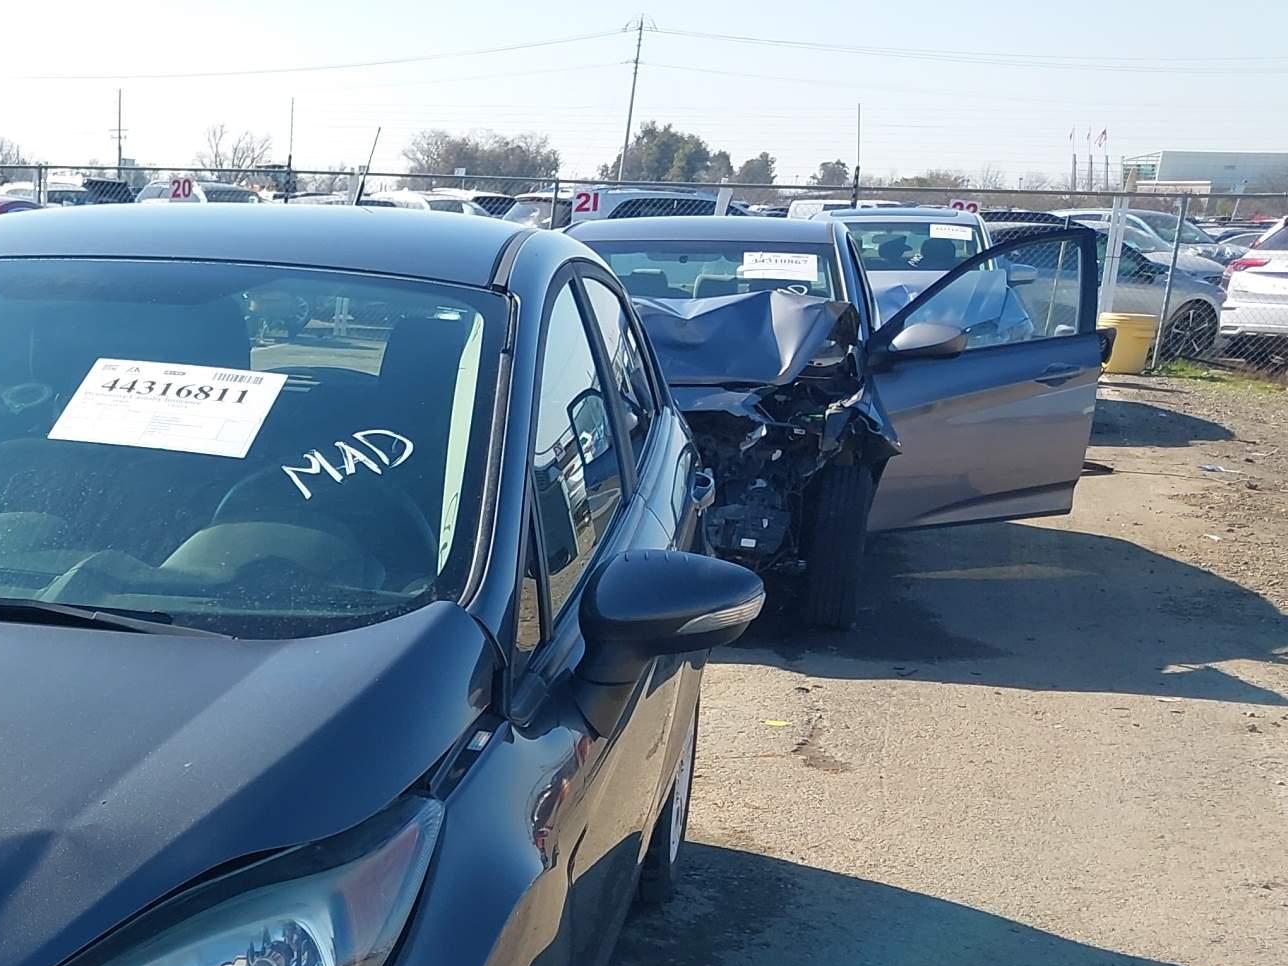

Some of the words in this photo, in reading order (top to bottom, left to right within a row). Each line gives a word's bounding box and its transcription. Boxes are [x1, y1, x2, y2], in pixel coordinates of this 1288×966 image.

[171, 178, 192, 199] 20
[574, 192, 599, 212] 21
[100, 377, 250, 404] 44316811
[281, 427, 414, 500] MAD
